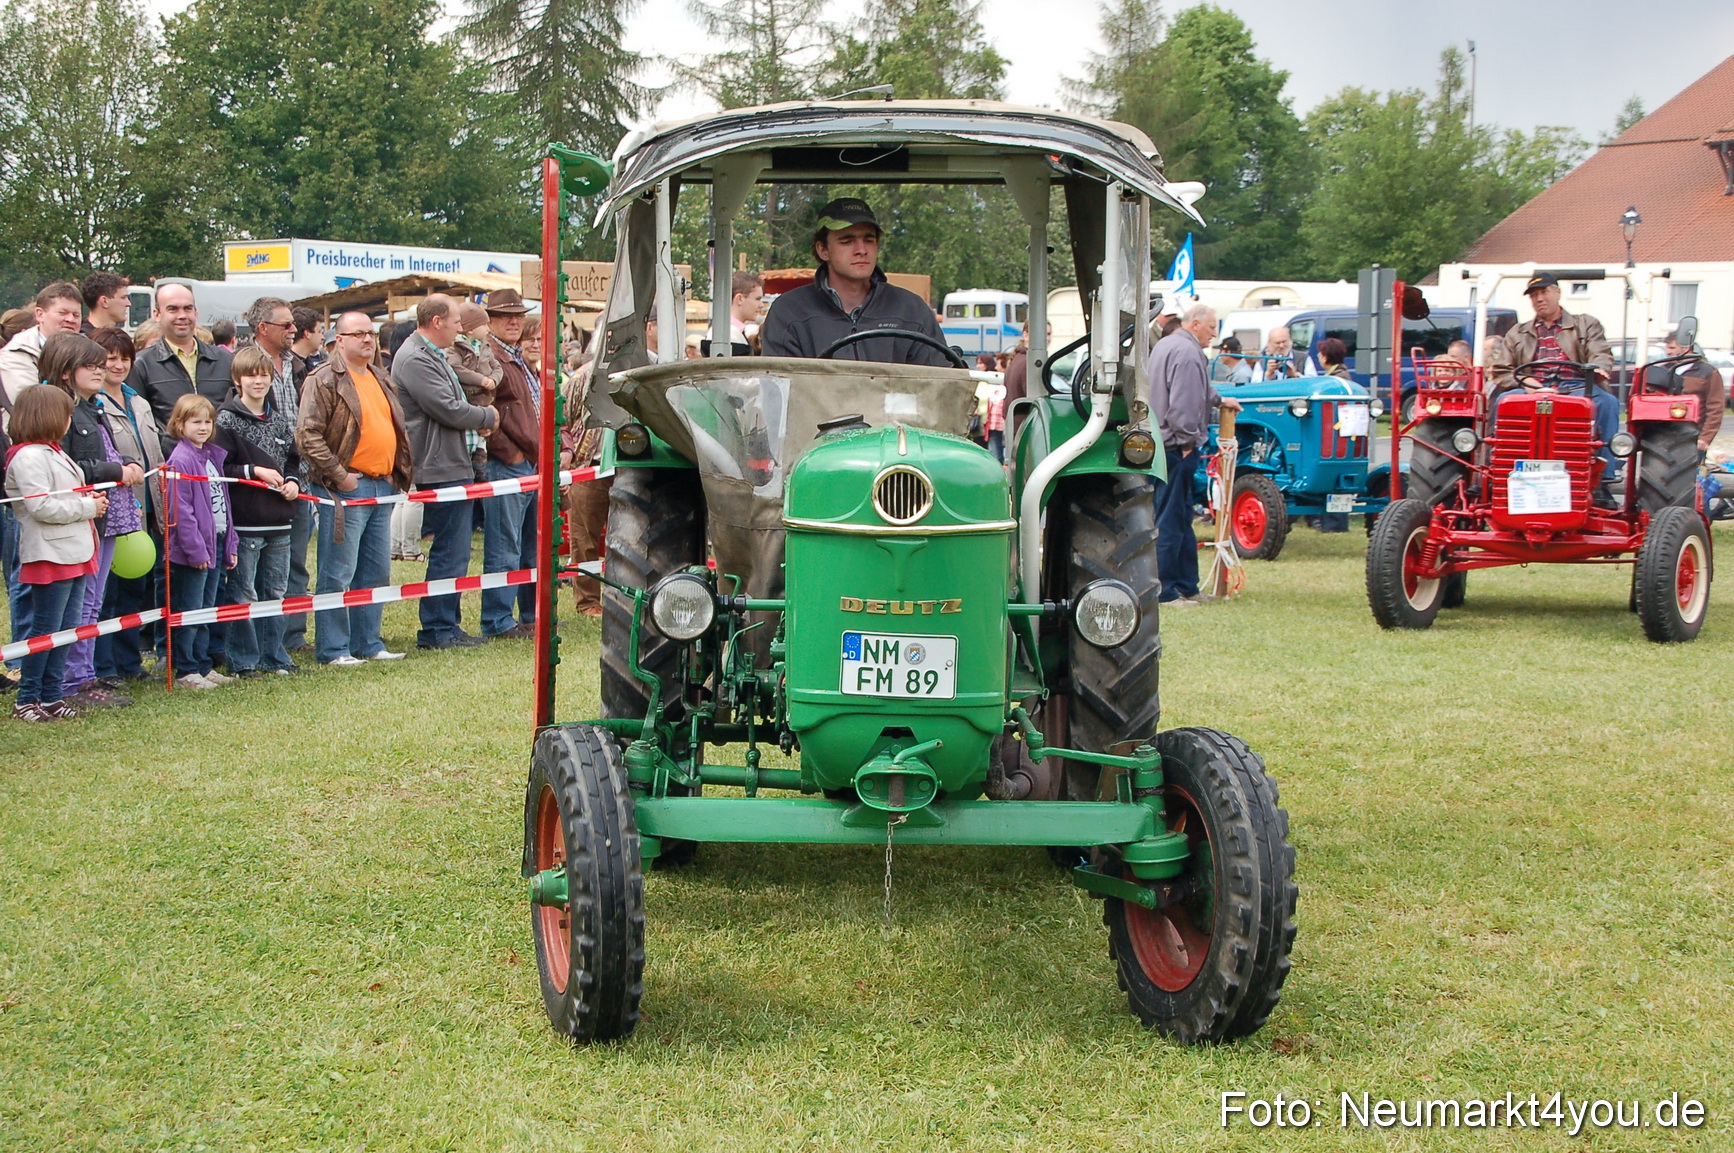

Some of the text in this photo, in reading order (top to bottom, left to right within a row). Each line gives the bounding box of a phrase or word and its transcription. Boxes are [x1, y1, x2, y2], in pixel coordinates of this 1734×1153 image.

[307, 248, 460, 273] Preisbrecher im Internet!
[1525, 462, 1540, 472] NM
[840, 596, 962, 615] DEUTZ
[848, 650, 856, 659] D
[863, 638, 900, 665] NM
[857, 666, 939, 694] FM 89
